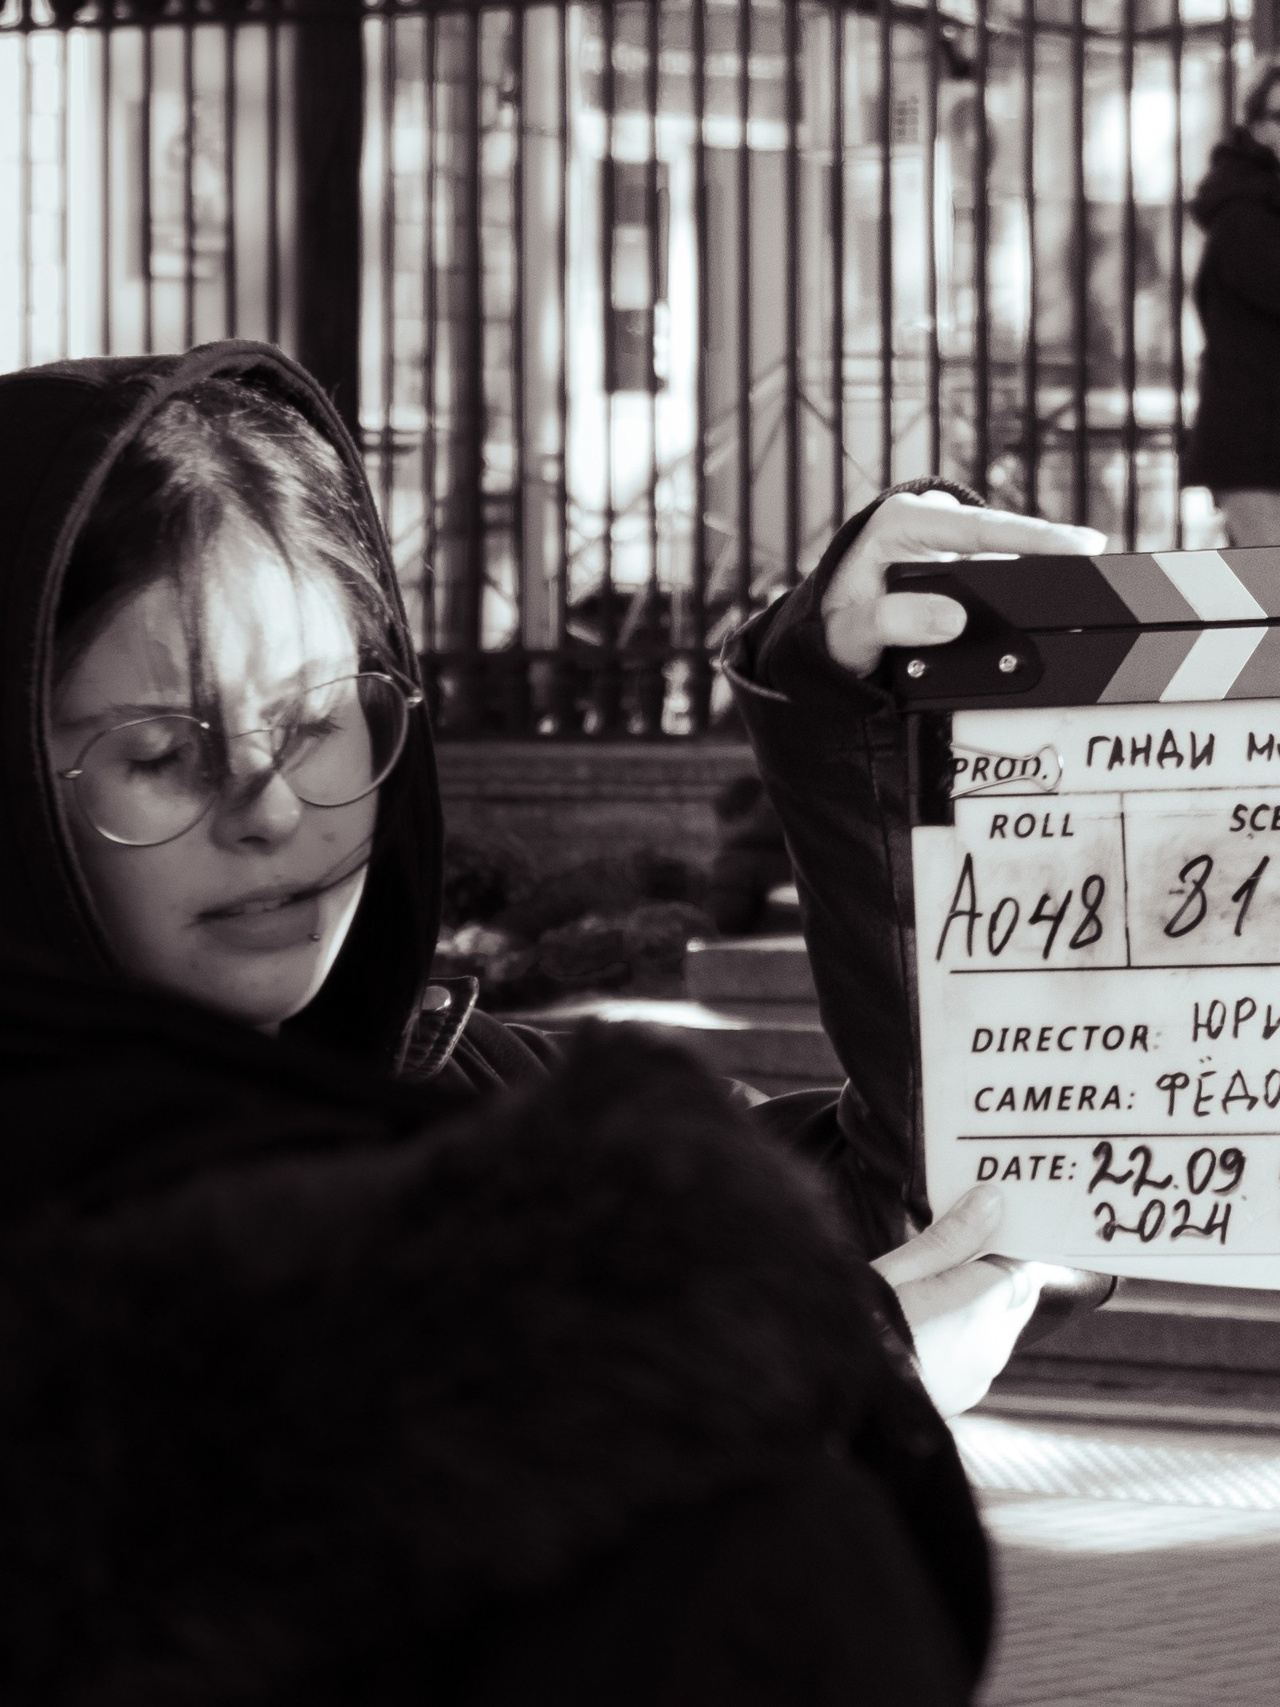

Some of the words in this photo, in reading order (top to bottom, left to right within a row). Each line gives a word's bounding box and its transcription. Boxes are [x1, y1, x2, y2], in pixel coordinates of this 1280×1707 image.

[1086, 728, 1215, 771] ГАНДИ
[952, 756, 1048, 782] PROD.
[989, 813, 1074, 839] ROLL
[935, 852, 1106, 960] A048
[974, 1085, 1136, 1112] CAMERA:
[976, 1155, 1077, 1181] DATE:
[1088, 1141, 1246, 1196] 22.09
[1094, 1199, 1232, 1245] 2024
